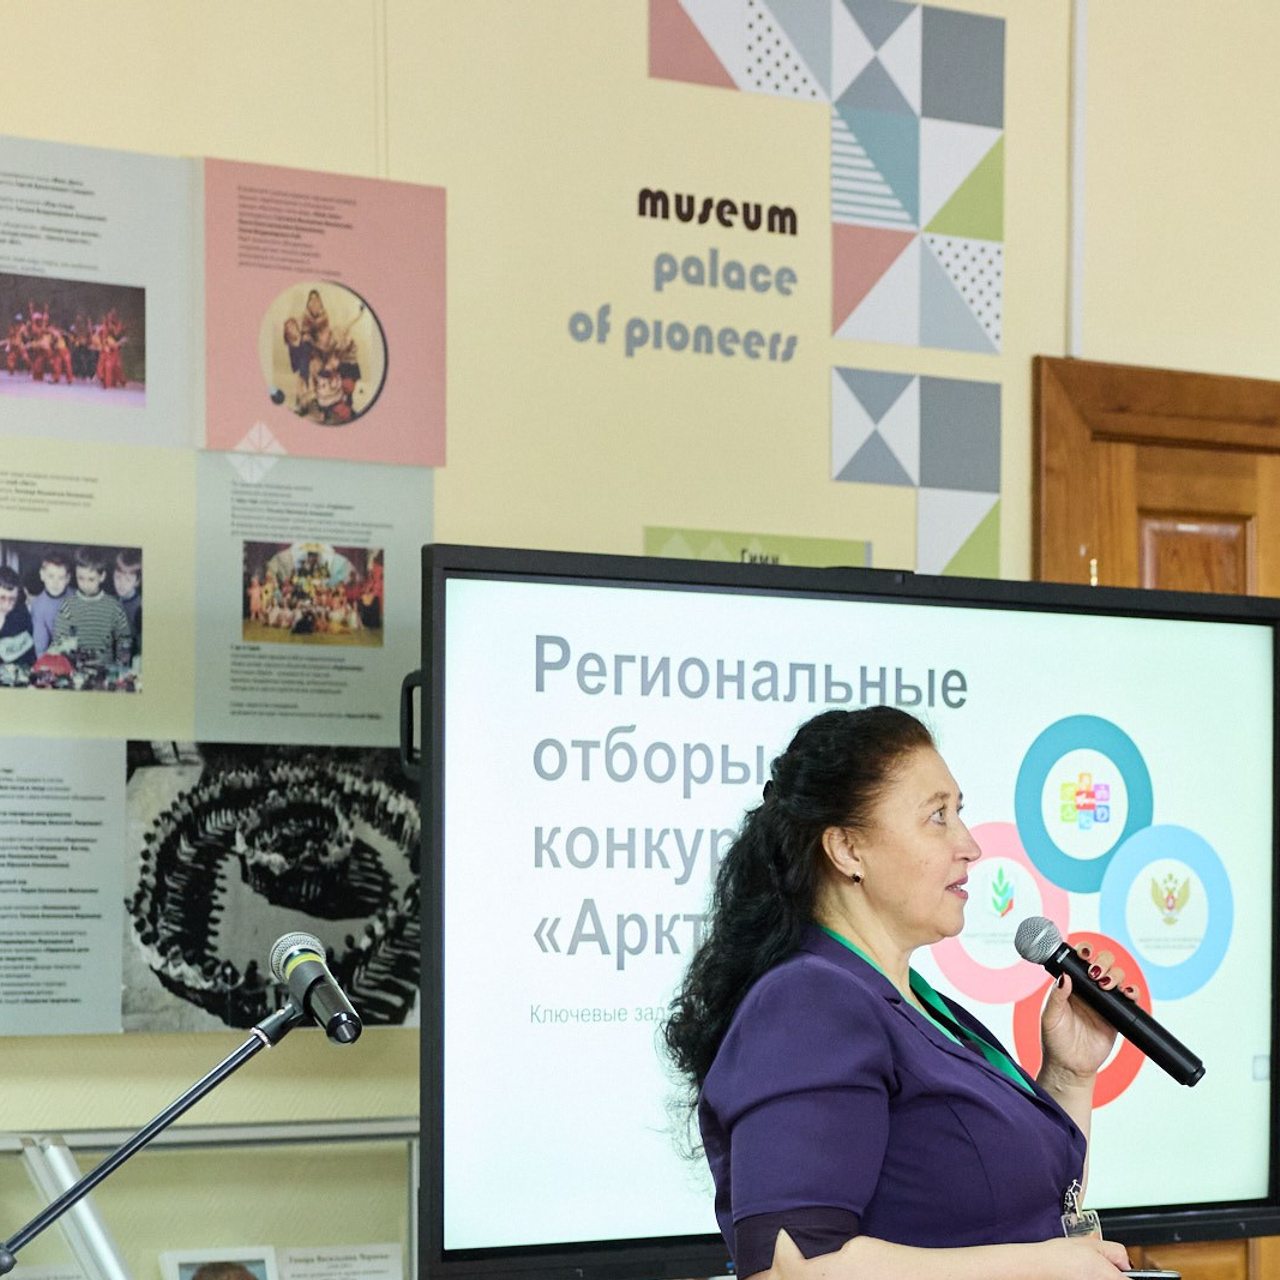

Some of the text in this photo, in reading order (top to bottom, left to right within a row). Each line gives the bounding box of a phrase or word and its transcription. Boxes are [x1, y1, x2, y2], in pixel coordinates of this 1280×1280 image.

[638, 187, 797, 236] museum
[654, 248, 798, 296] palace
[568, 303, 798, 363] of pioneers
[535, 634, 968, 709] Региональные
[533, 724, 764, 799] отборы
[530, 1005, 671, 1024] Ключевые зад
